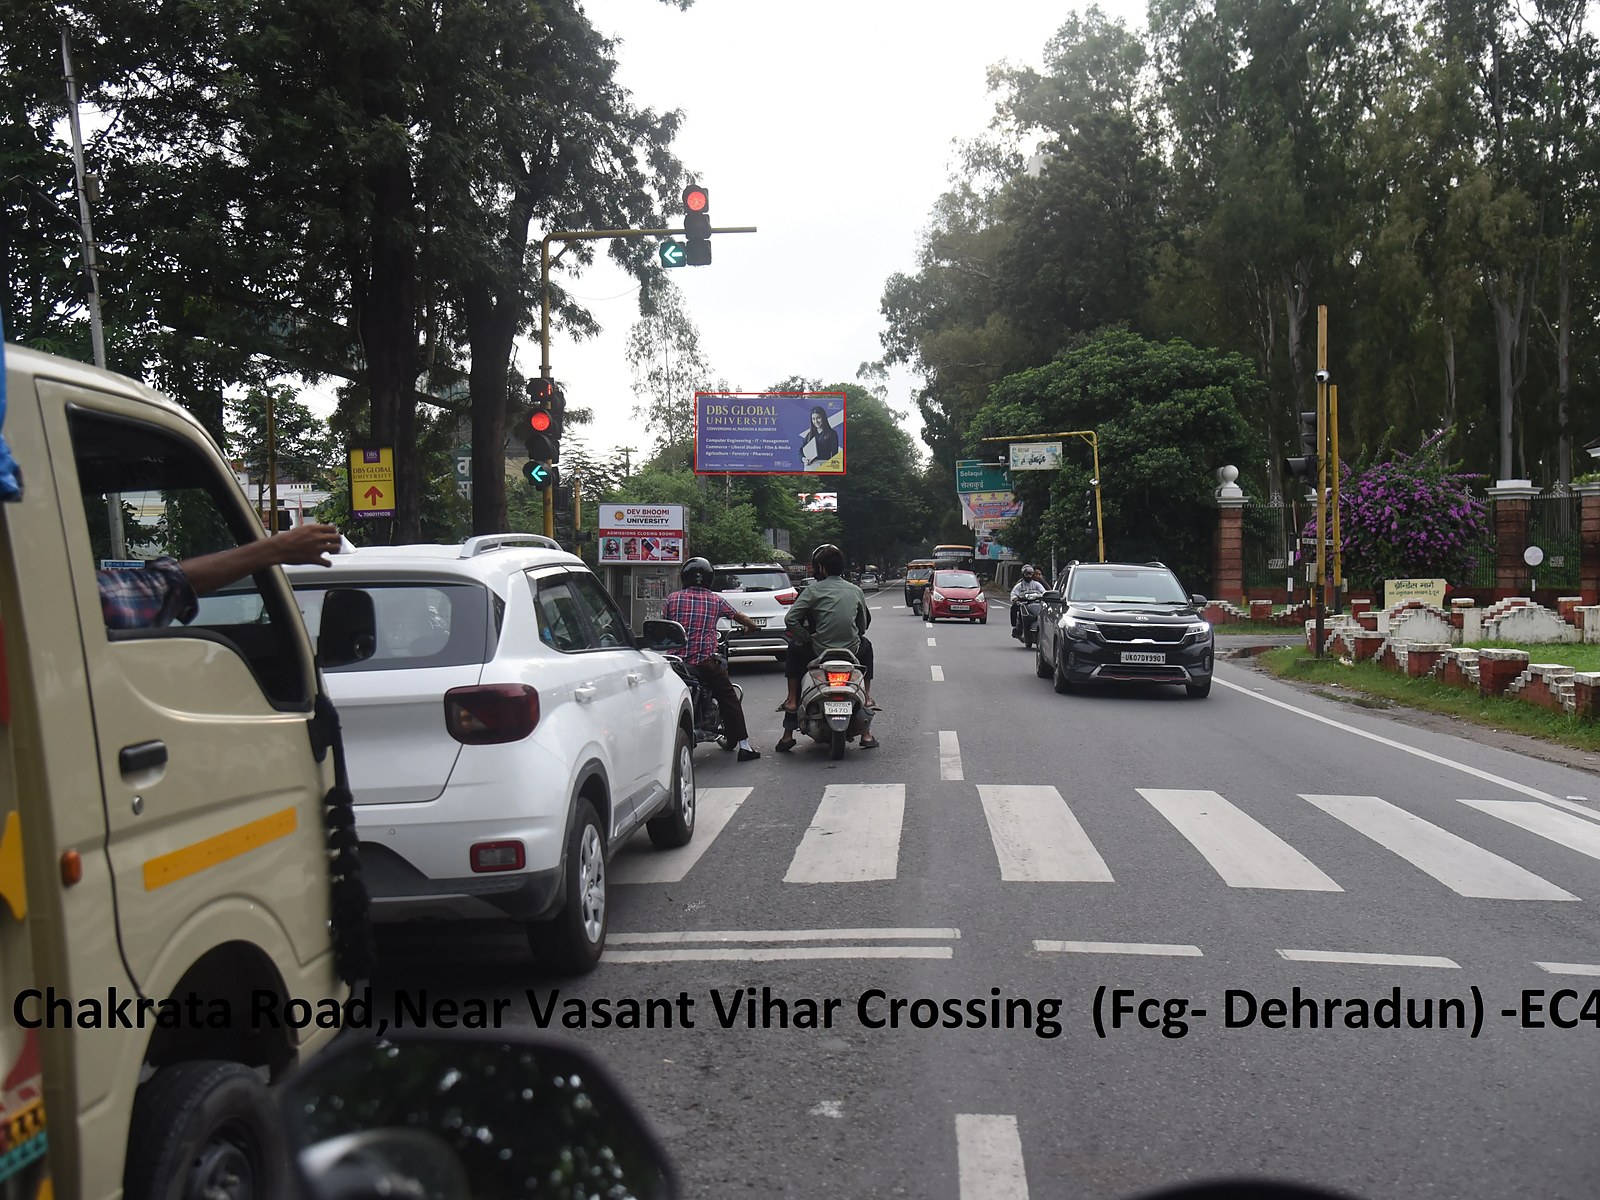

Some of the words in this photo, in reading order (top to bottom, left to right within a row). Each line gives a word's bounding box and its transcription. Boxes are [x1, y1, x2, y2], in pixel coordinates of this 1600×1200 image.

[706, 405, 729, 415] DBS
[731, 405, 778, 416] GLOBAL
[706, 417, 778, 425] UNIVERSITY
[1420, 580, 1434, 588] मार्ग
